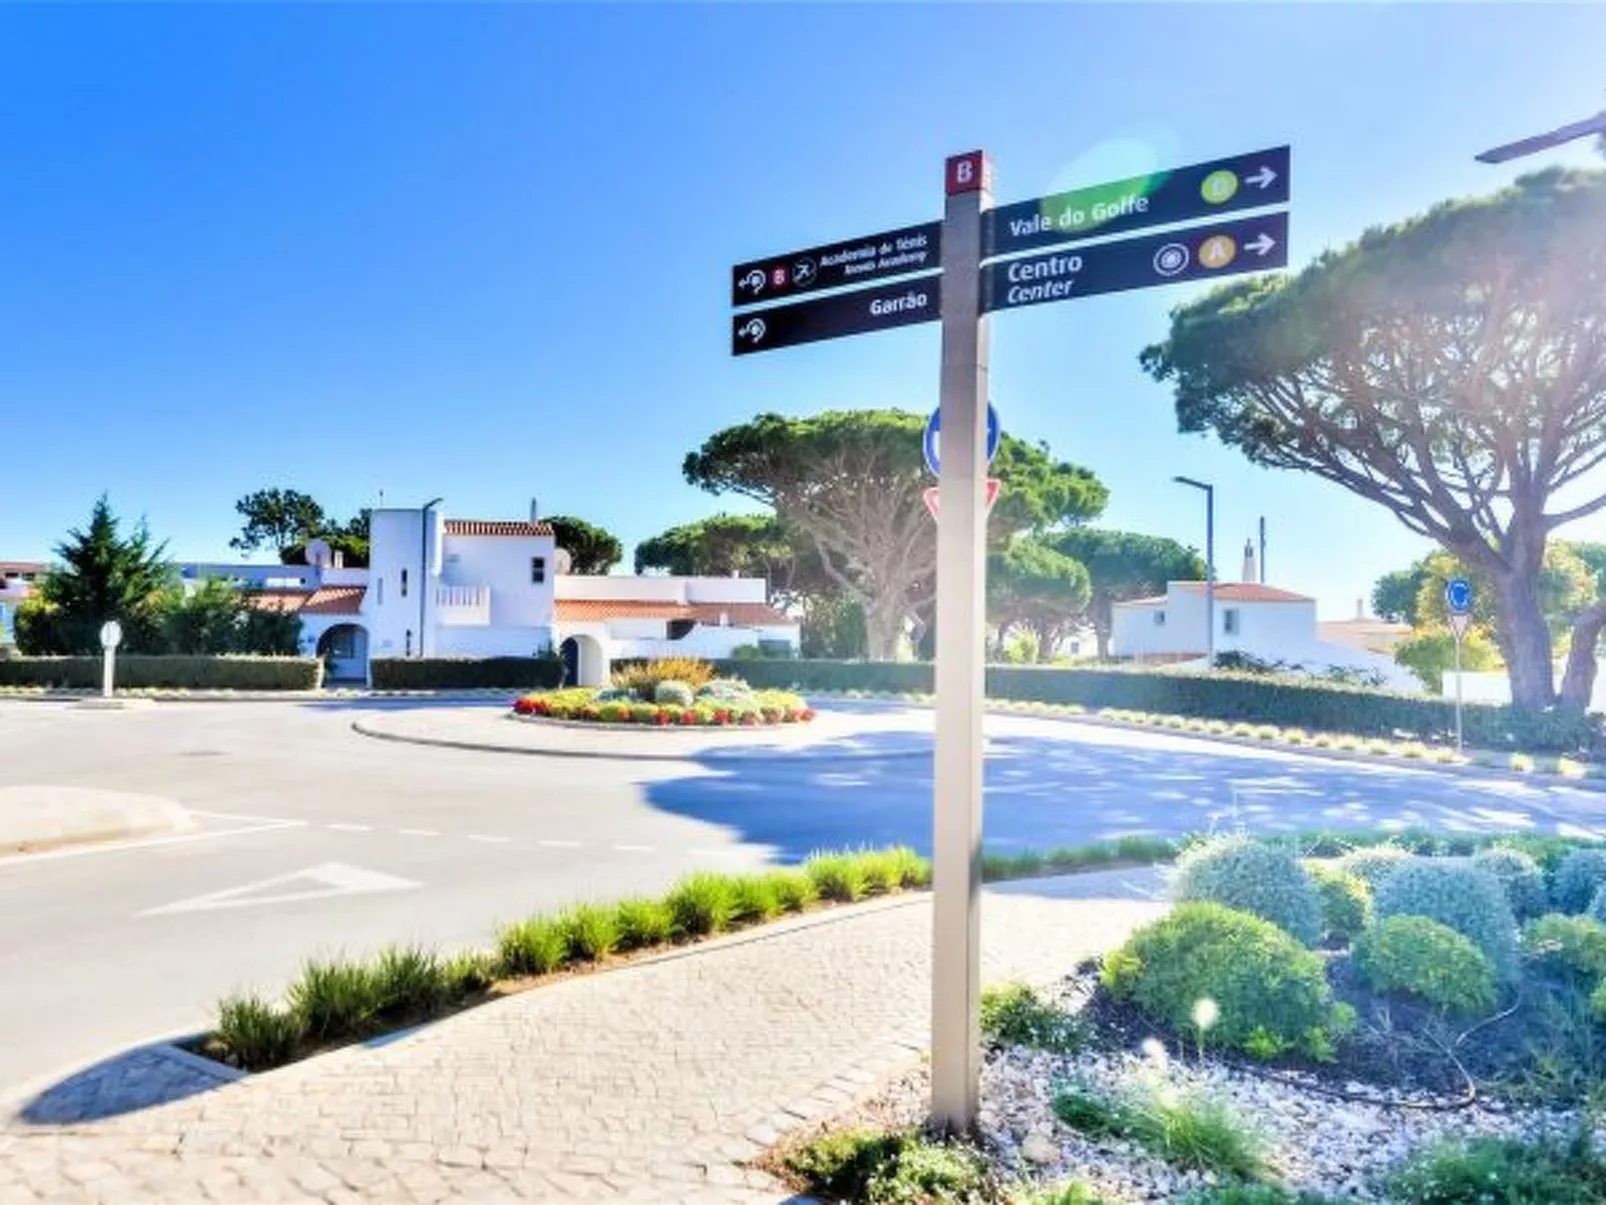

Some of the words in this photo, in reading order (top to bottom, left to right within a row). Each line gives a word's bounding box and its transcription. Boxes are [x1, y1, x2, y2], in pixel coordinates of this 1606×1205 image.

[956, 161, 972, 183] B
[1009, 215, 1052, 236] Vale
[1059, 206, 1085, 227] do
[1091, 194, 1149, 220] Golfe
[1008, 255, 1083, 281] Centro
[870, 292, 928, 315] Garrão
[1007, 280, 1074, 304] Center
